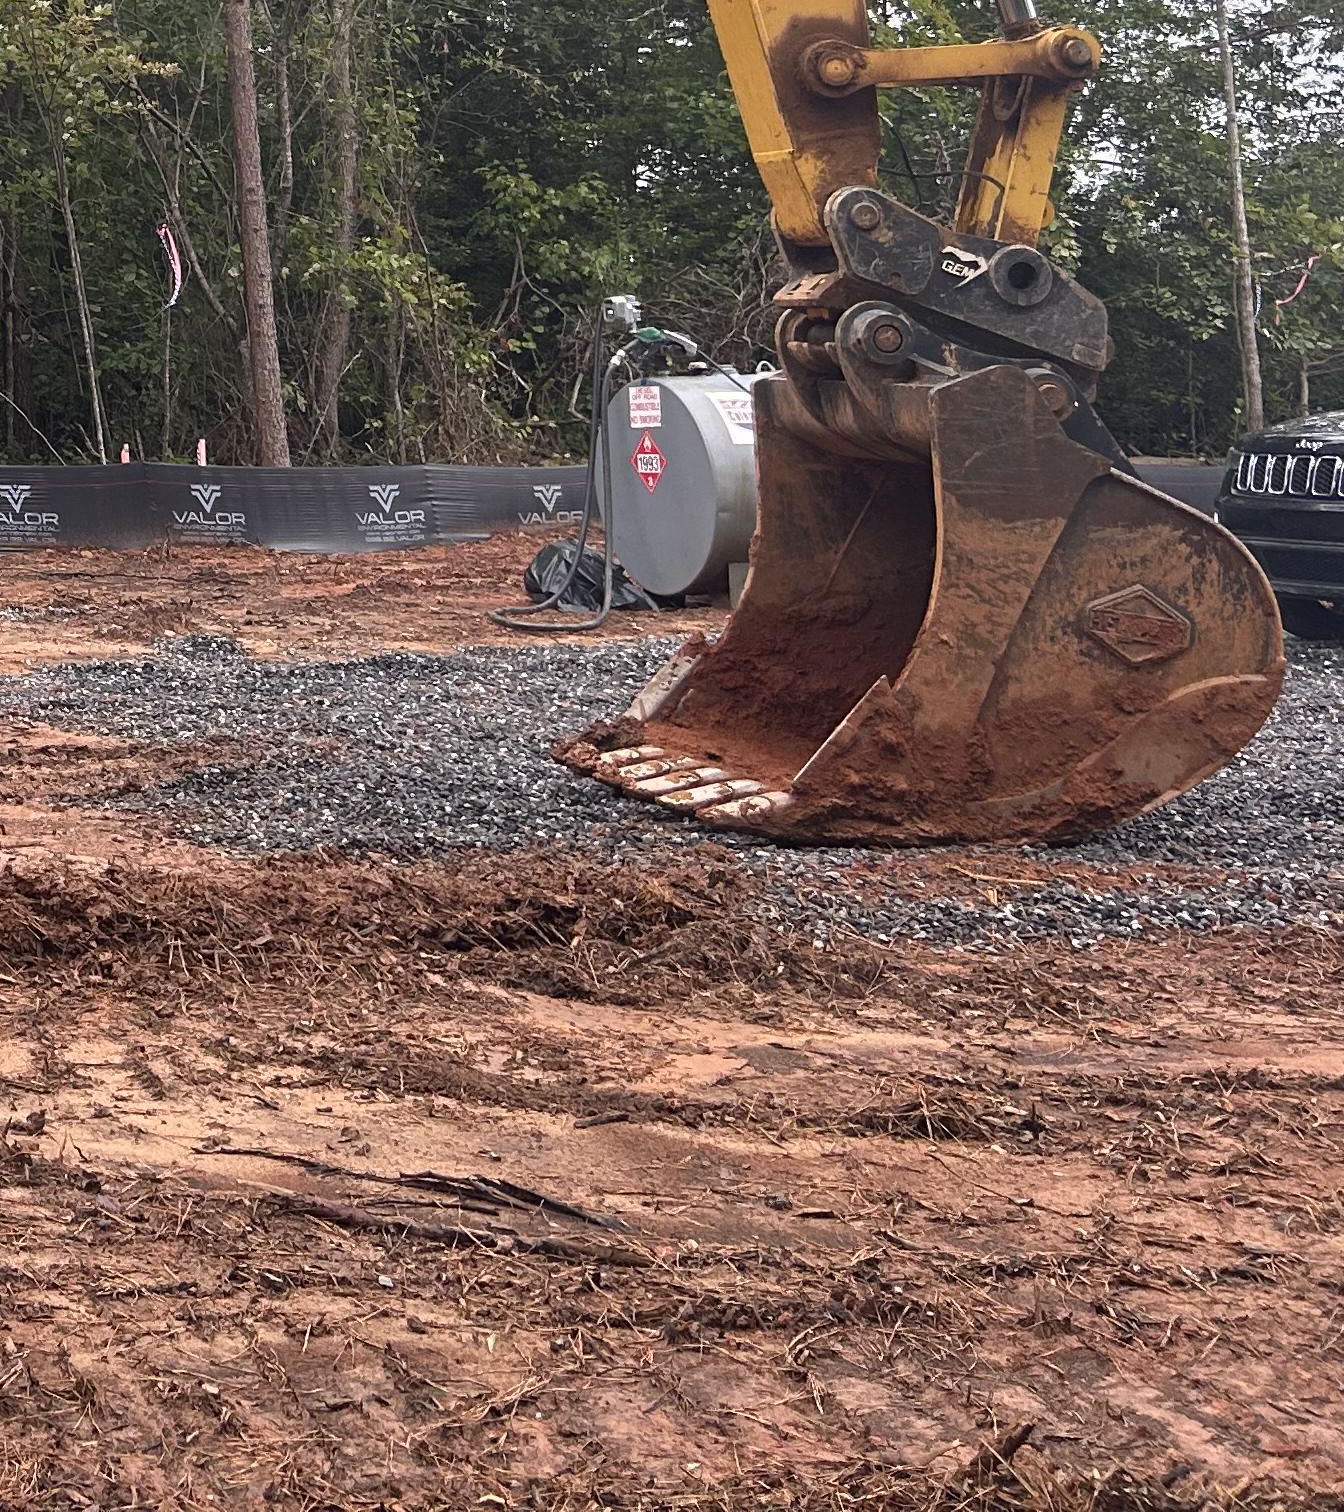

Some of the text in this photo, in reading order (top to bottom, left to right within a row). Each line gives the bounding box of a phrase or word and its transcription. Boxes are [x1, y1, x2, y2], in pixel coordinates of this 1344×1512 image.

[638, 455, 659, 472] 1993
[172, 510, 247, 525] VALOR
[355, 509, 426, 525] VALOR
